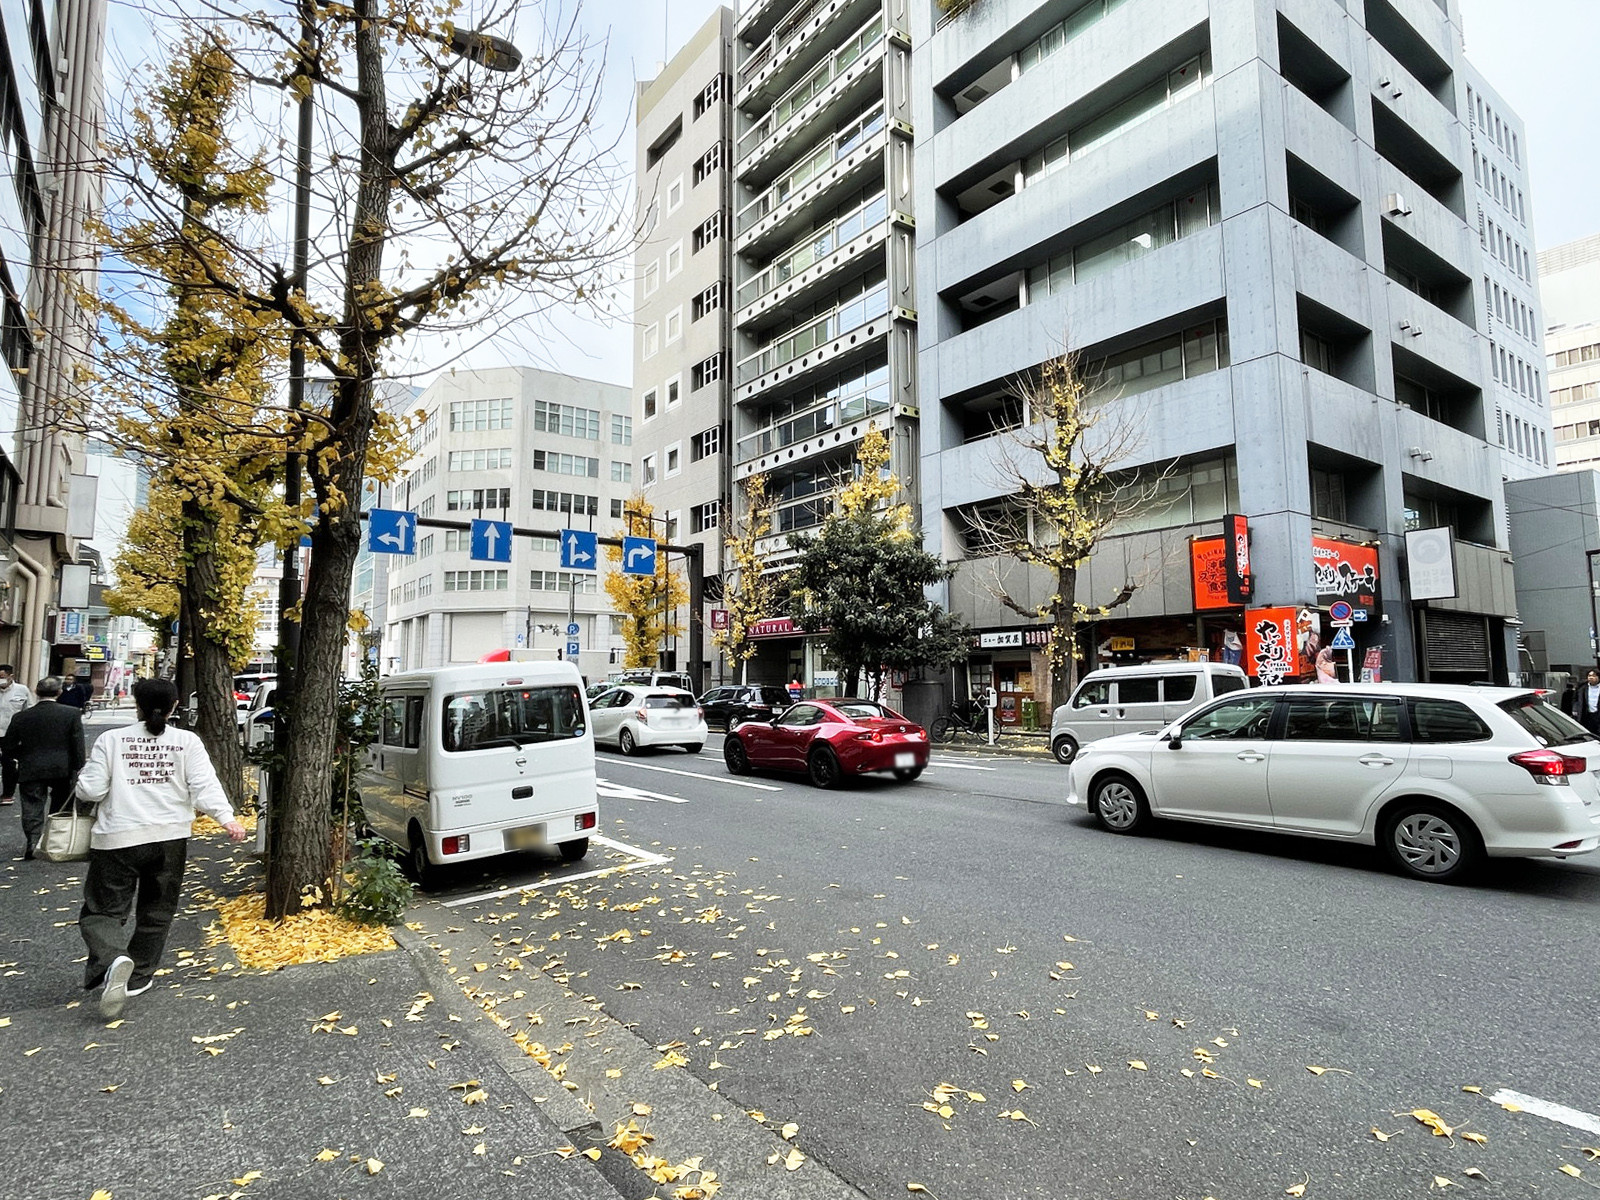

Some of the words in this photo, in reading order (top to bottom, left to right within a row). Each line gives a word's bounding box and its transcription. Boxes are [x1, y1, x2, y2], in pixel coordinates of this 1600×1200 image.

[1200, 571, 1227, 582] ステー
[748, 623, 790, 635] NATURAL
